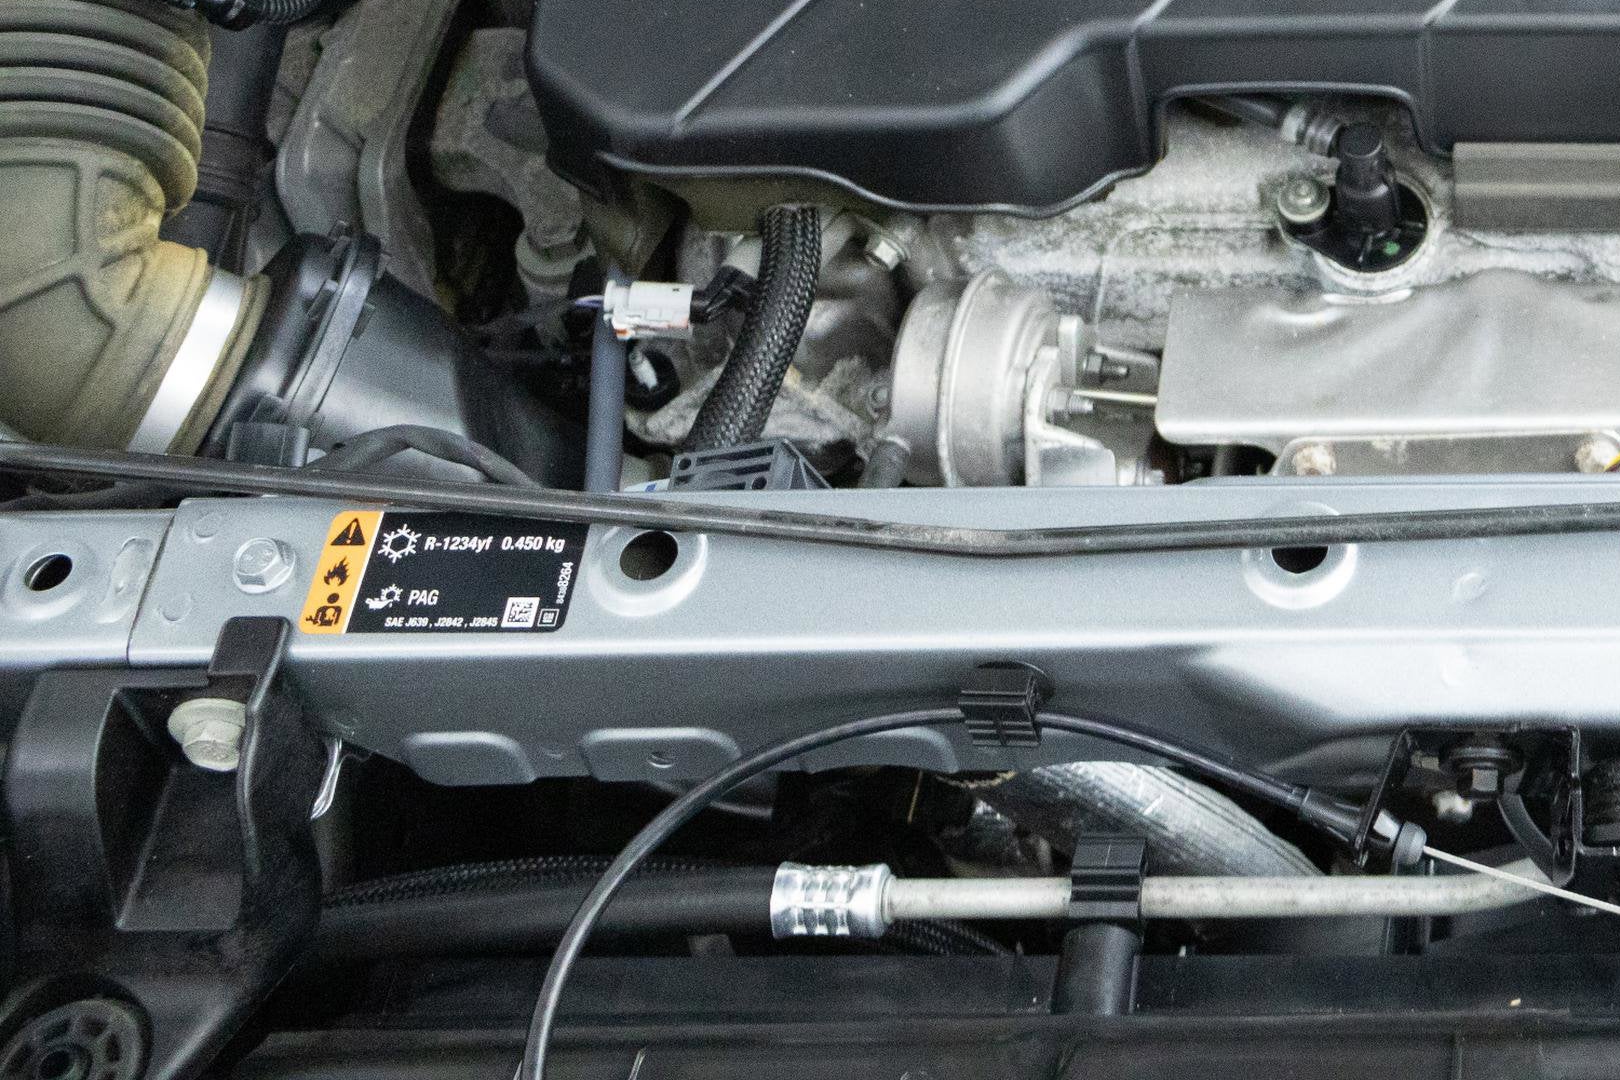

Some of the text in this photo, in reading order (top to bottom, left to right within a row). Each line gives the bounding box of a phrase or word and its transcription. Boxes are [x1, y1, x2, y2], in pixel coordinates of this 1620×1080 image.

[424, 536, 566, 553] R-1234yf 0.450 kg
[407, 590, 439, 606] PAG
[384, 617, 403, 627] SAE
